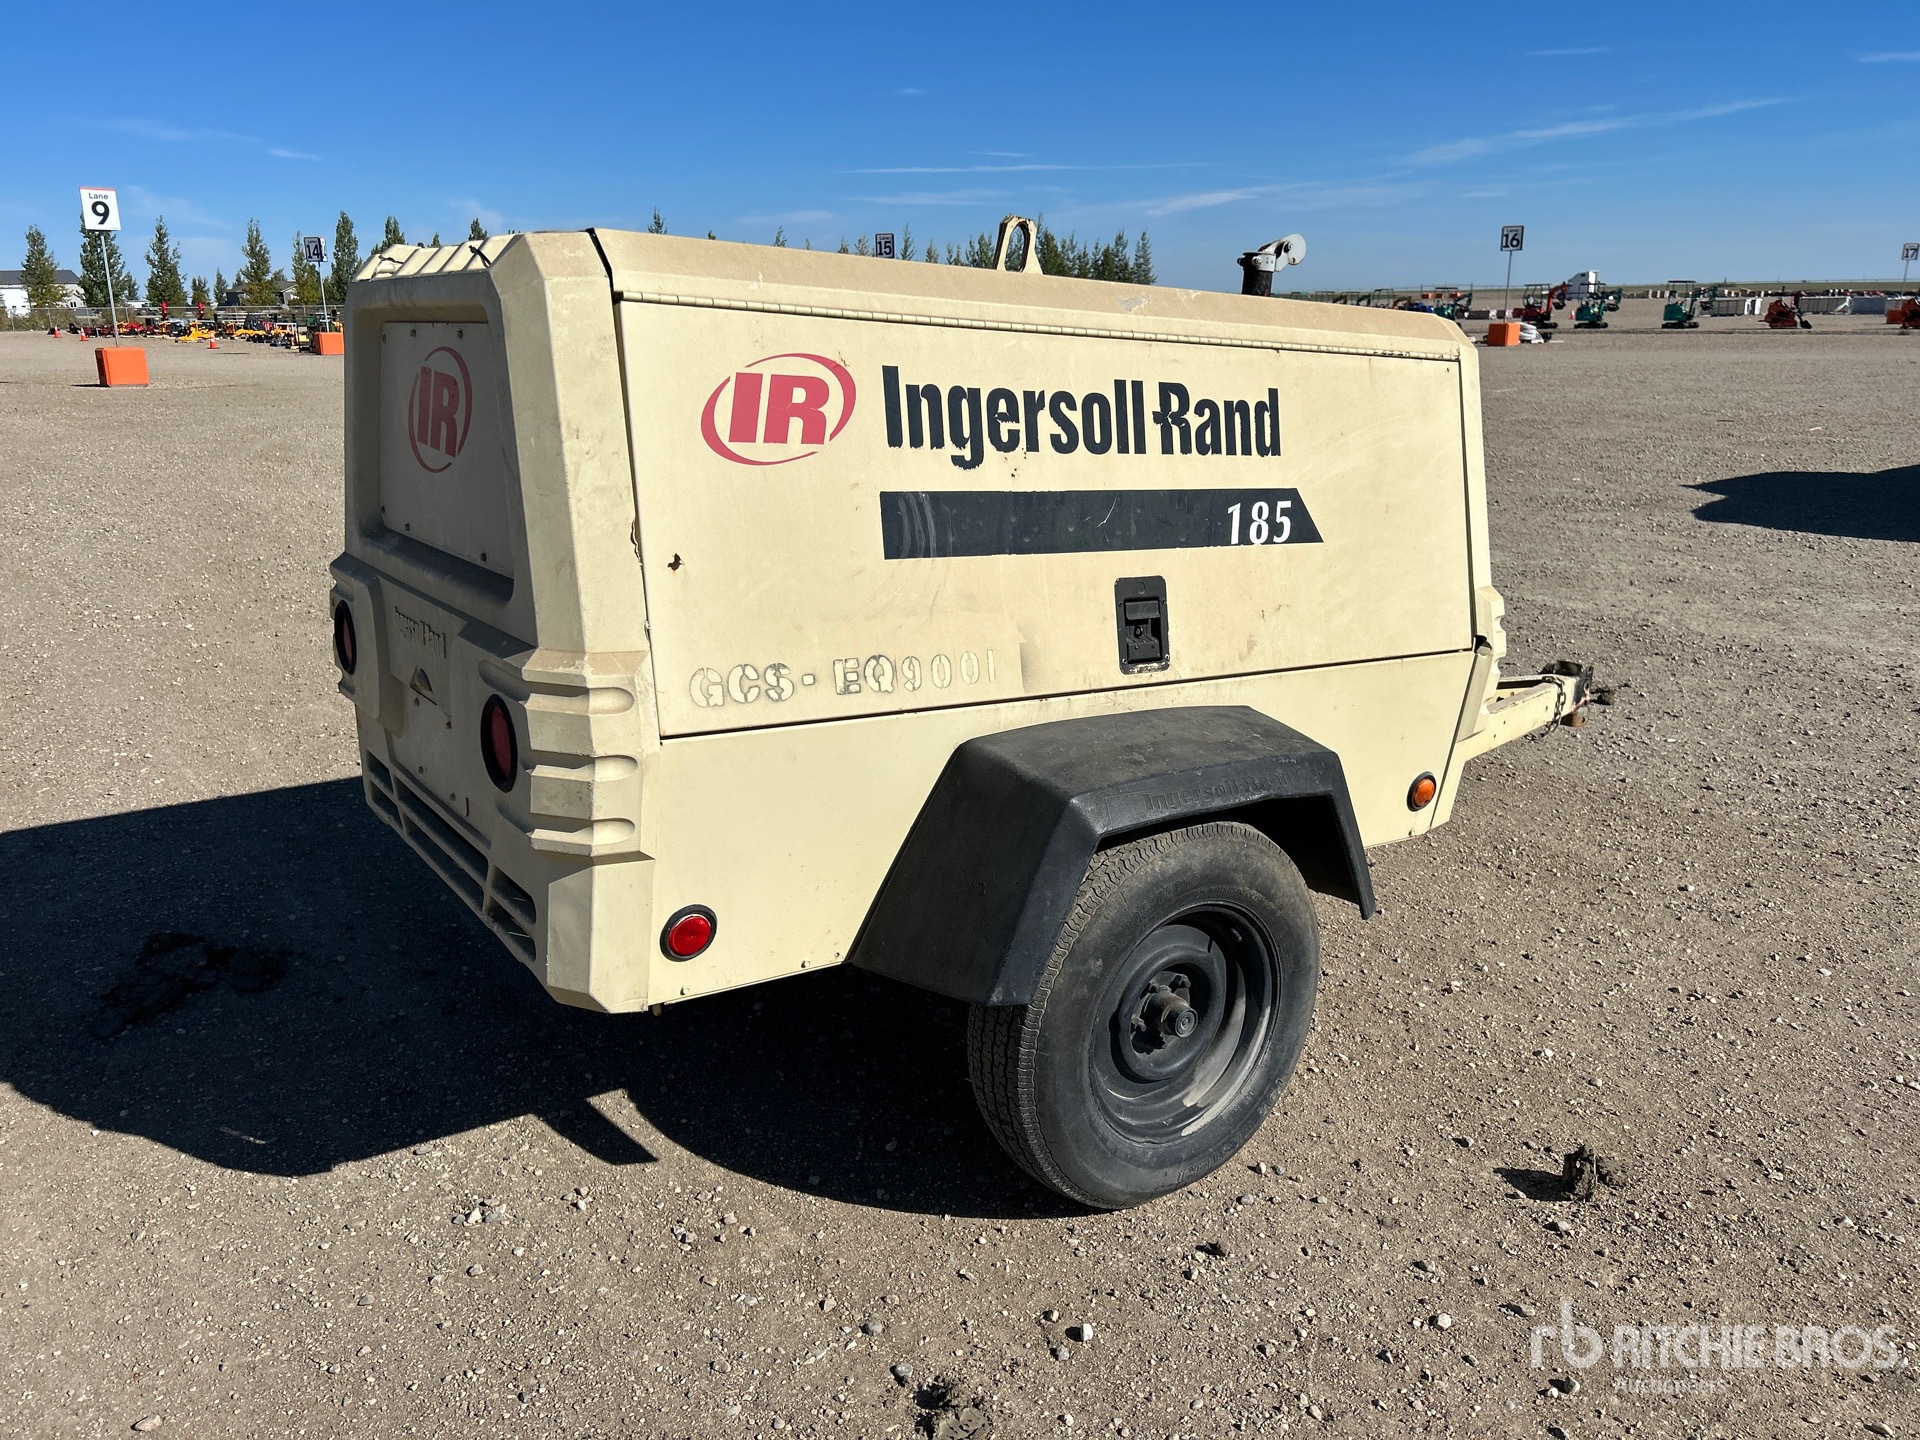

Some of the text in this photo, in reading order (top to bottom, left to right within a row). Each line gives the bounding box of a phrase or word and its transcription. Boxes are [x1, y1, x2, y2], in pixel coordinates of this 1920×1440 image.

[88, 192, 109, 200] Lane
[91, 200, 110, 225] 9
[877, 240, 892, 256] 15
[1503, 233, 1520, 248] 16
[306, 244, 320, 259] 14
[1903, 248, 1918, 259] 17
[417, 366, 459, 458] IR
[727, 371, 829, 447] IR
[1227, 500, 1292, 545] 185
